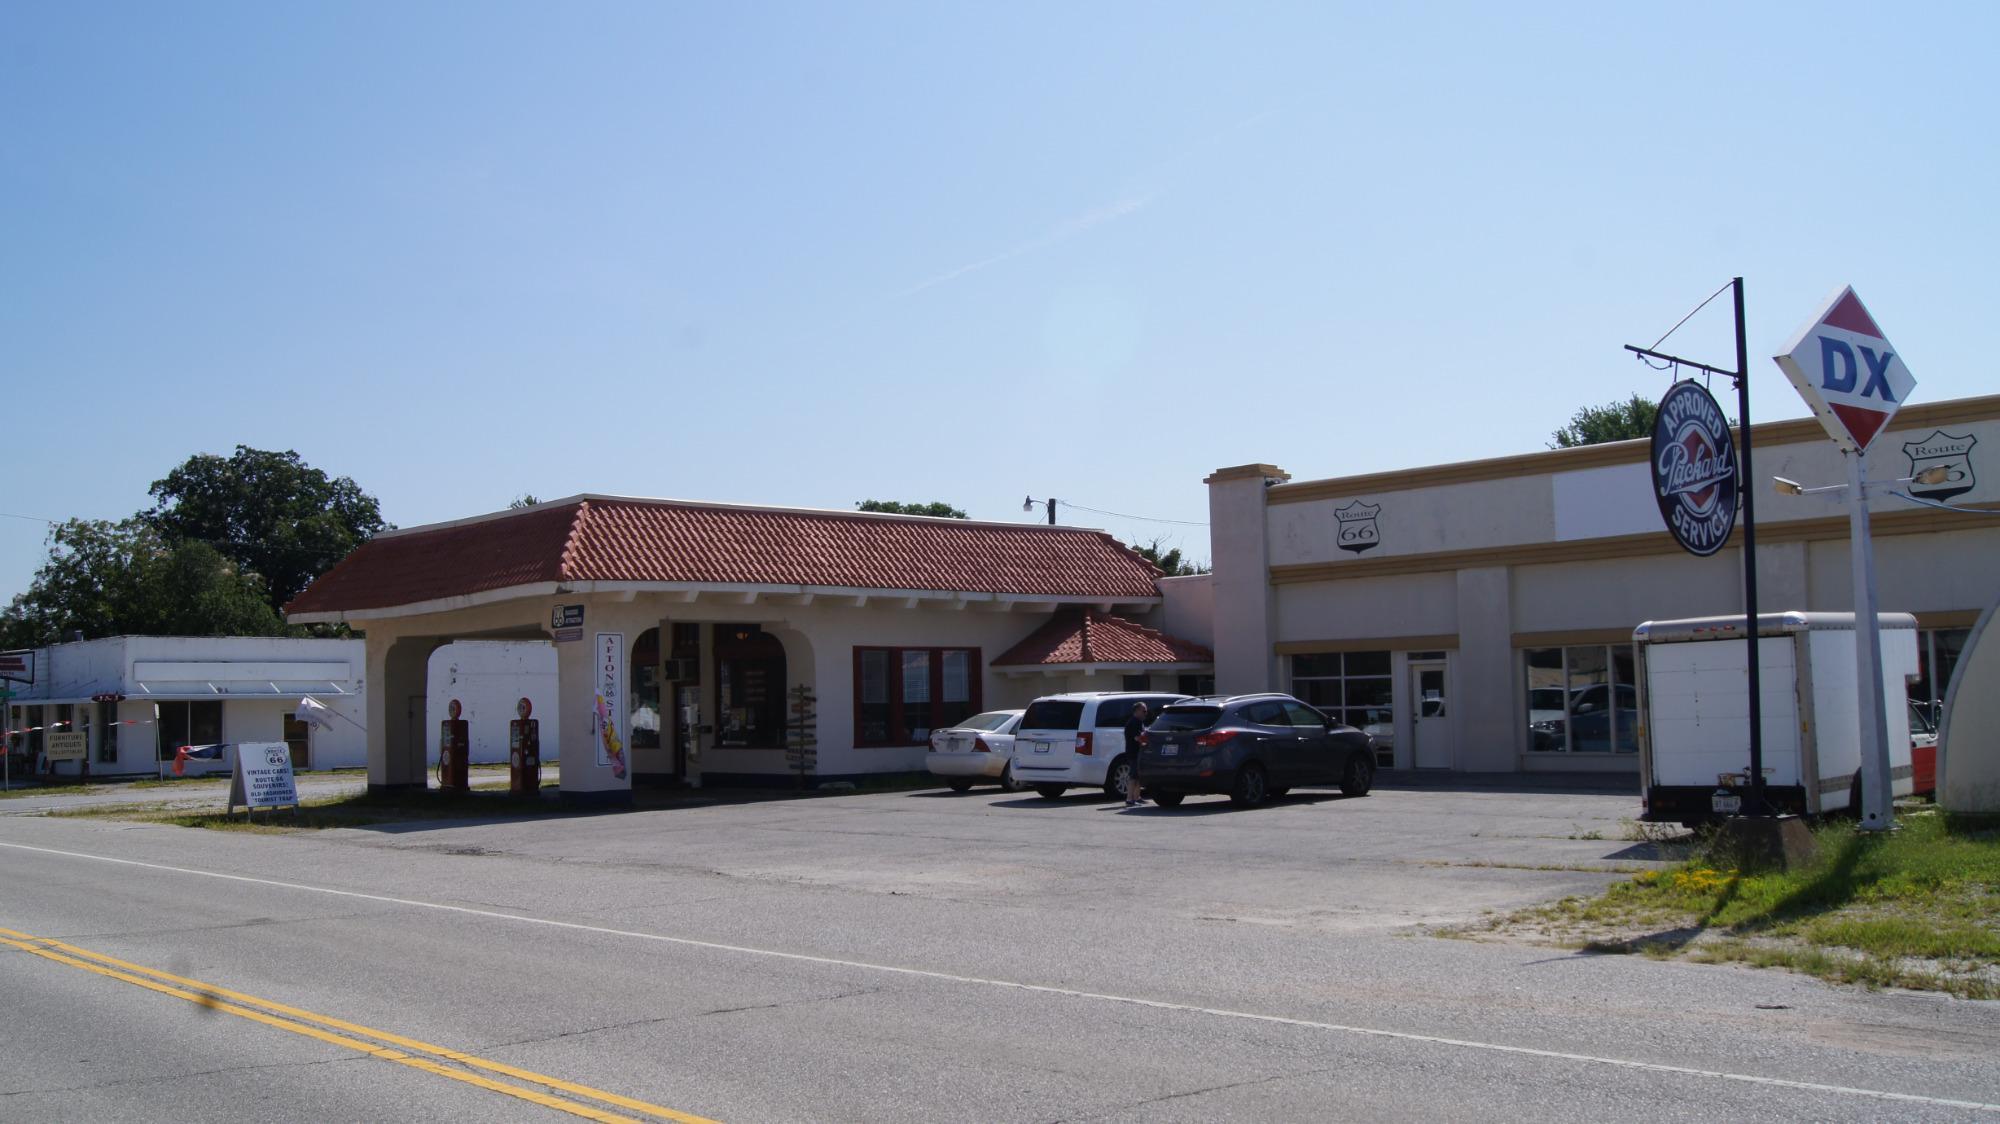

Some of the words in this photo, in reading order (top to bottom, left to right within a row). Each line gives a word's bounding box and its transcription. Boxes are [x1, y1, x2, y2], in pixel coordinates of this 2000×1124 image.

[1817, 335, 1898, 403] DX
[1663, 391, 1722, 440] APPROVED
[1657, 441, 1733, 497] Packard
[1915, 443, 1965, 456] Route
[1341, 511, 1374, 519] Route
[1341, 524, 1374, 541] 66
[1672, 502, 1729, 547] SERVICE
[604, 637, 615, 681] AFTON
